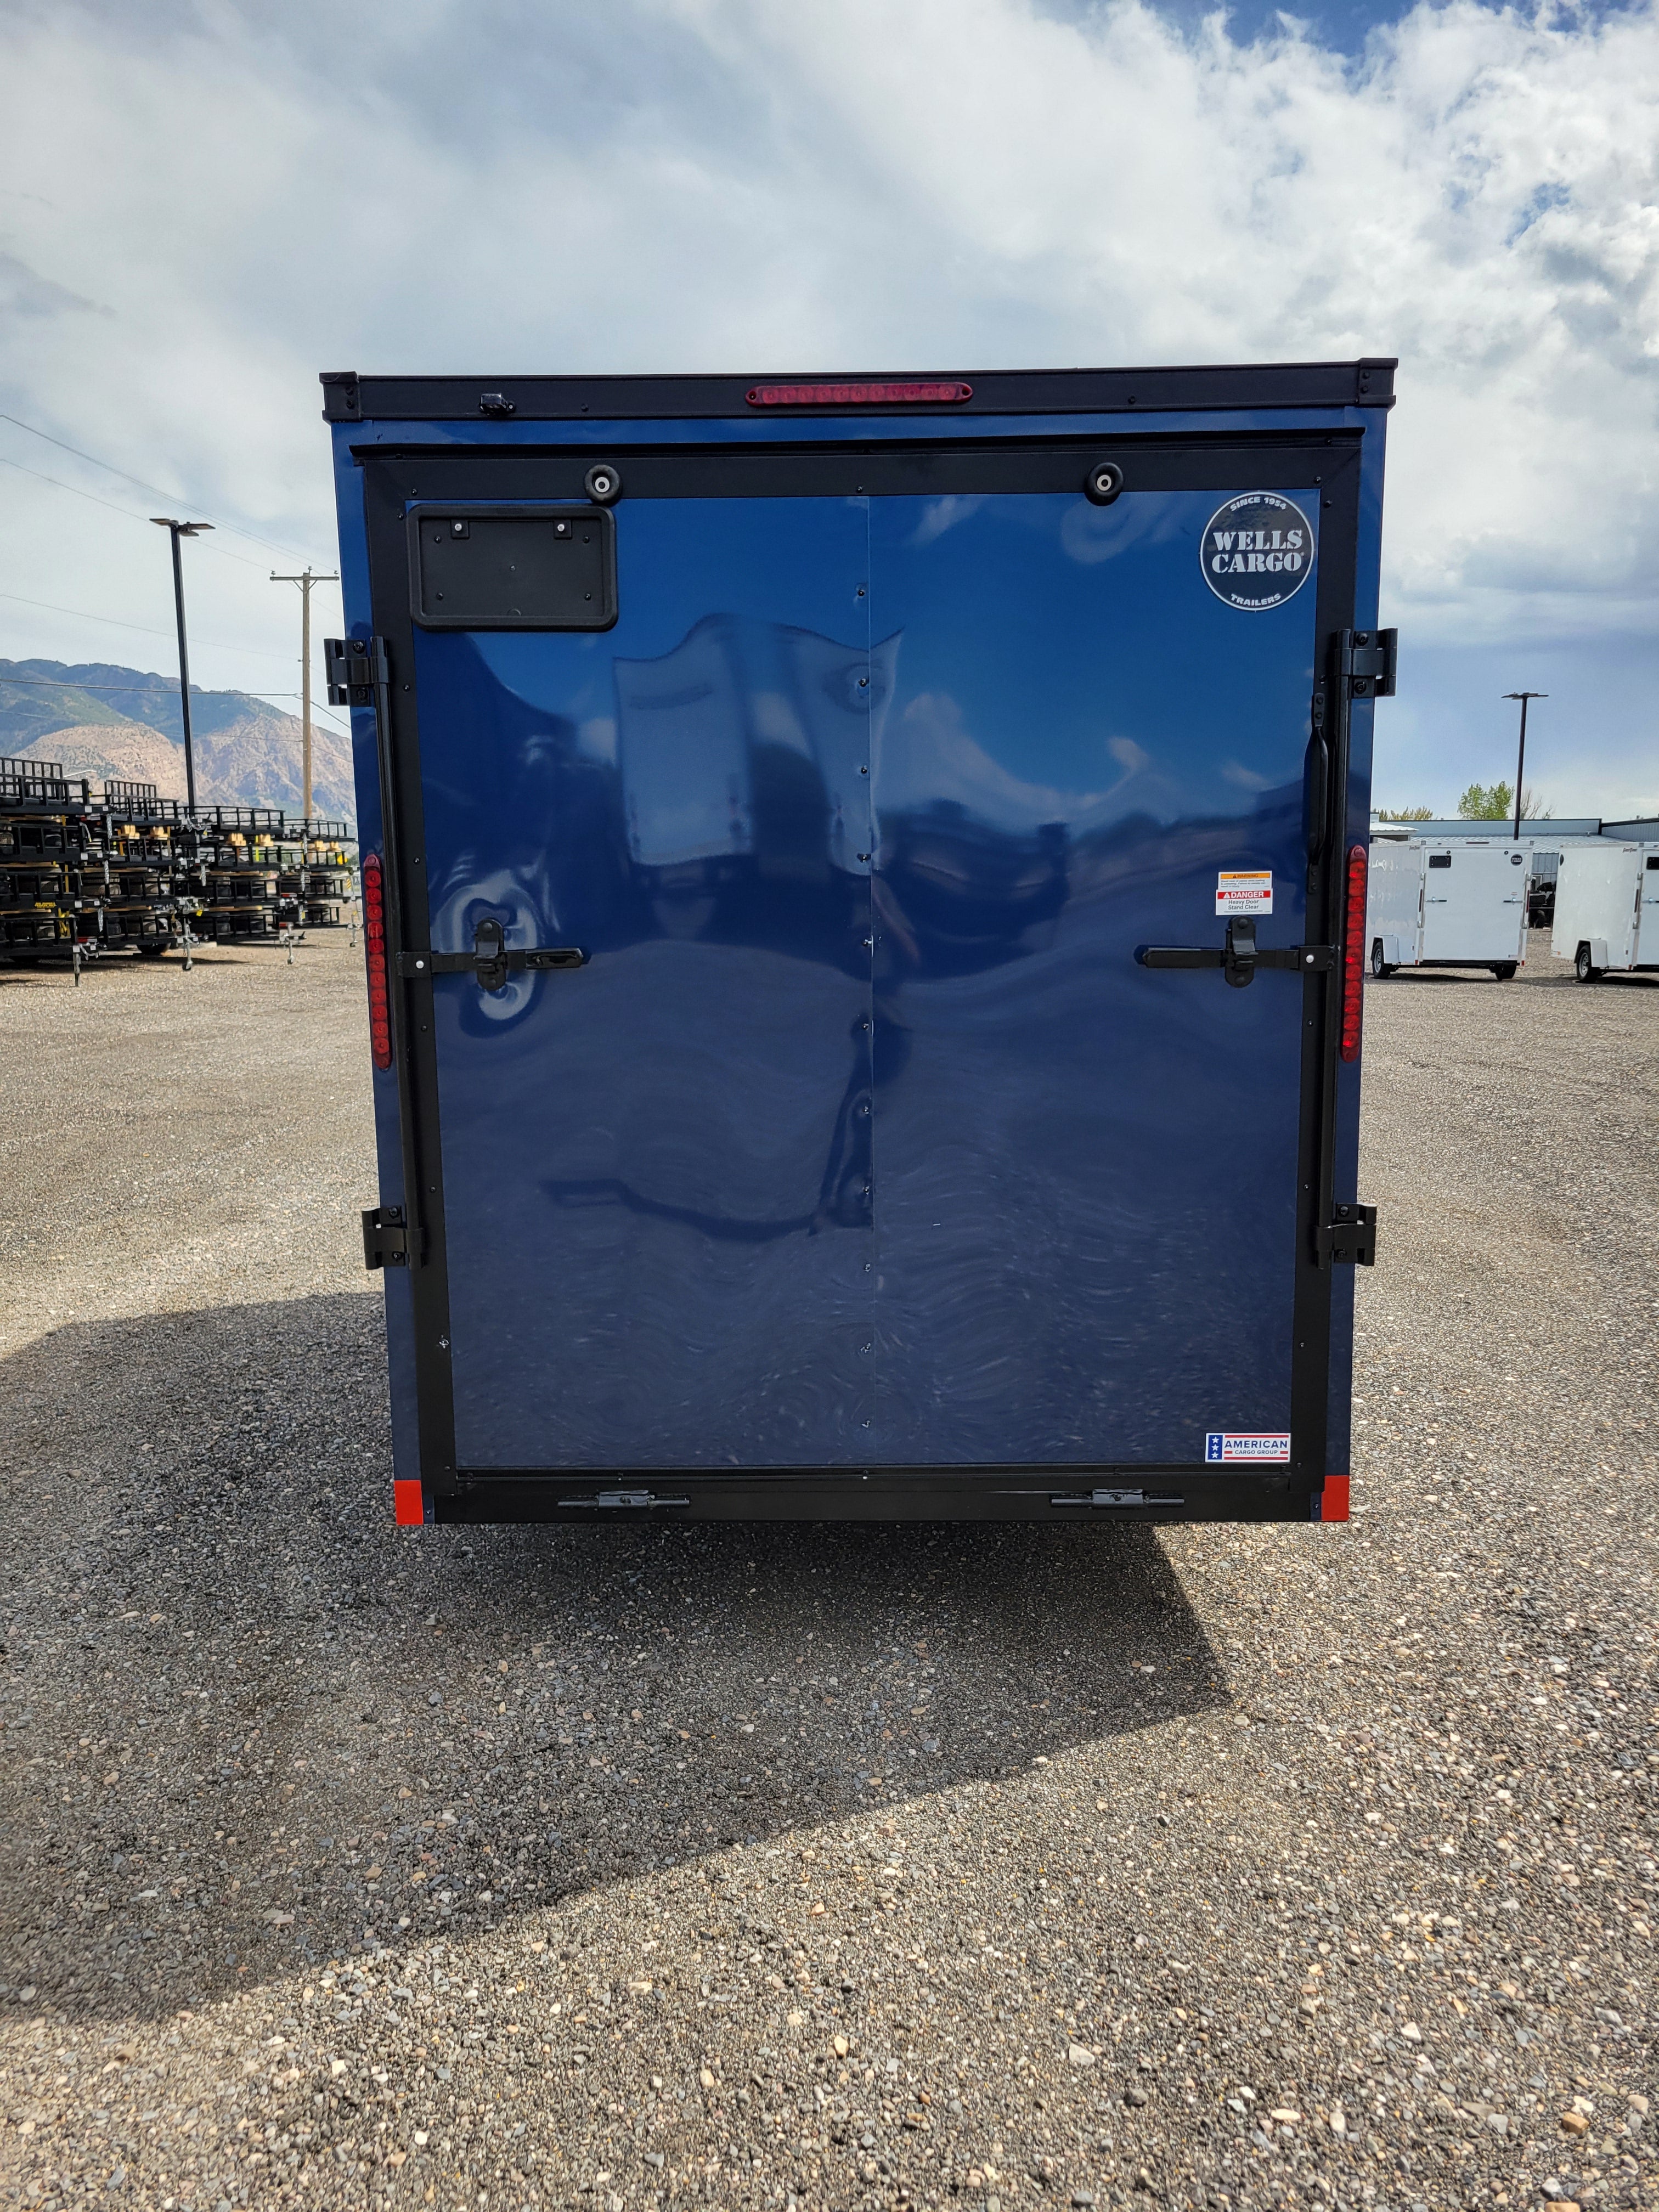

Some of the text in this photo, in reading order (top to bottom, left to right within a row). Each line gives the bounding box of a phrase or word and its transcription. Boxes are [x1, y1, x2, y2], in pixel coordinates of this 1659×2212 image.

[1230, 496, 1287, 511] SINCE 1954
[1213, 529, 1302, 551] WELLS
[1211, 552, 1302, 573] CARGO
[1231, 593, 1282, 606] TRAILERS
[1224, 1440, 1288, 1448] AMERICAN
